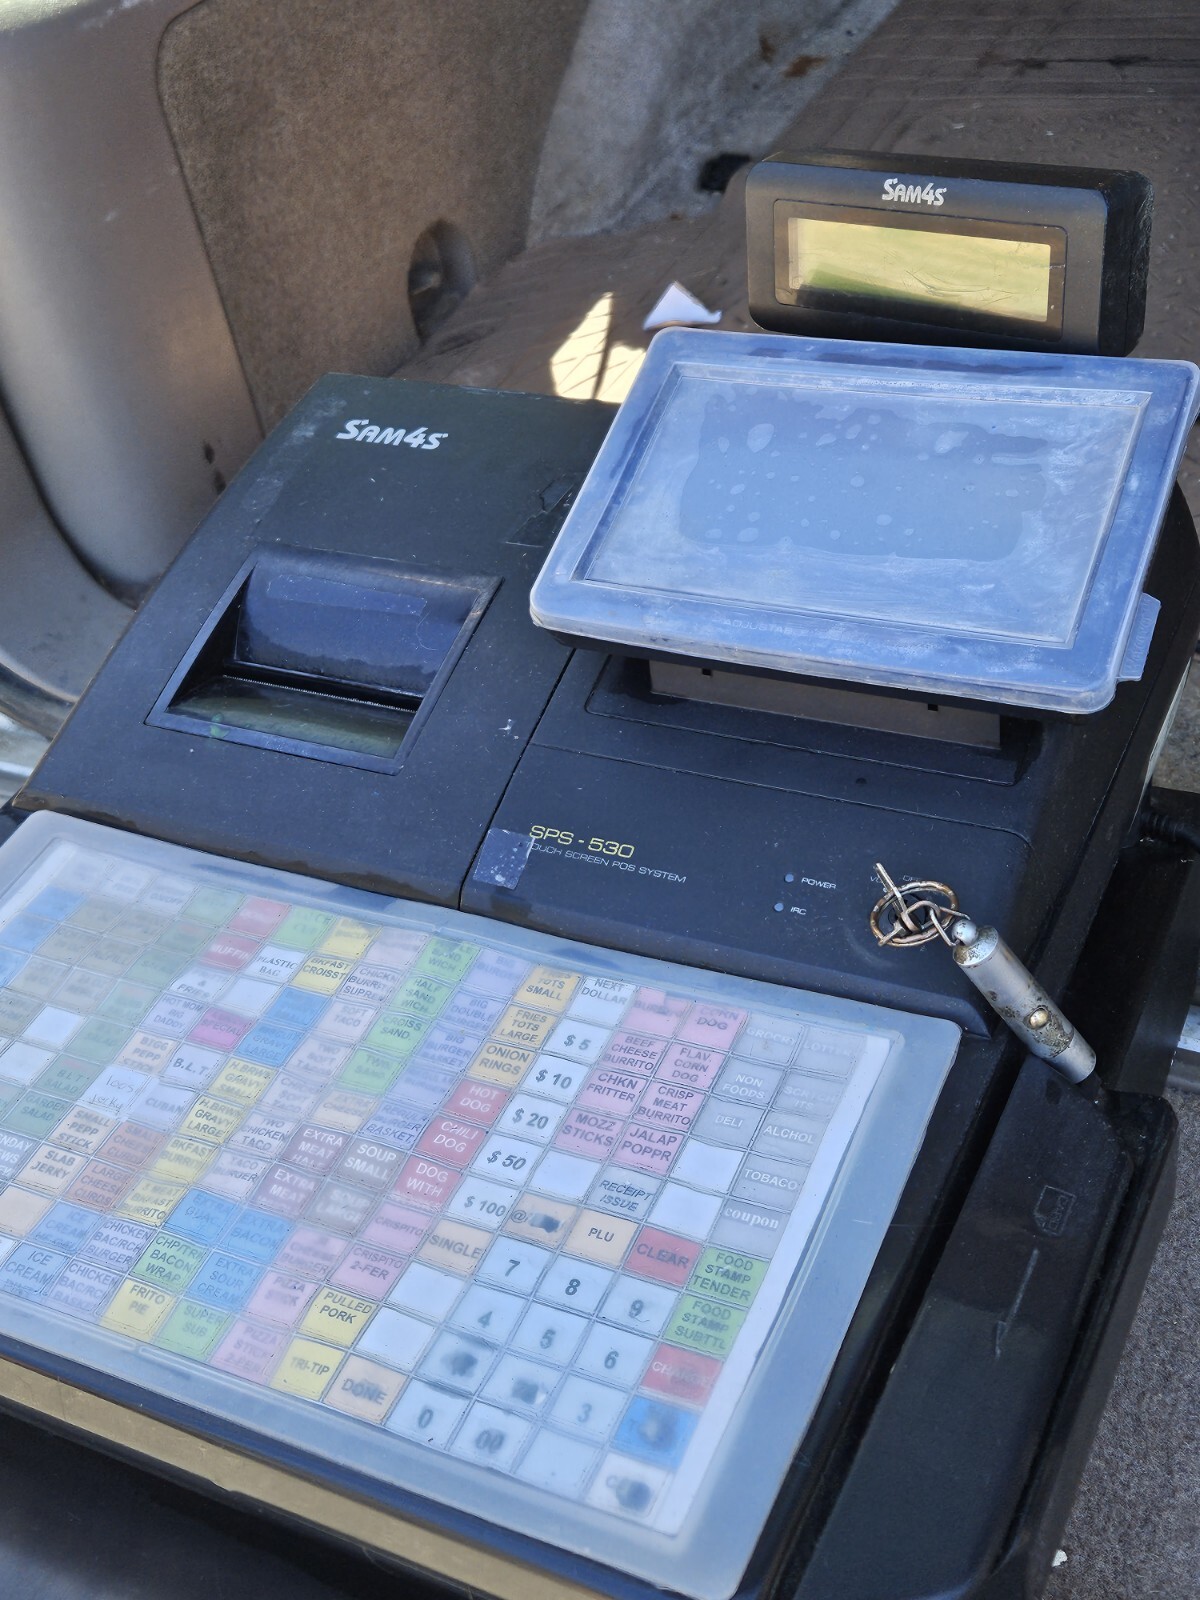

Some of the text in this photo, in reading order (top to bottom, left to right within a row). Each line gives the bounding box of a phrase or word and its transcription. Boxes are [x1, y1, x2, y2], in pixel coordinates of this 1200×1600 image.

[529, 825, 574, 845] SPS
[588, 837, 635, 859] 530
[565, 850, 609, 866] SCREEN
[612, 861, 635, 872] POS
[638, 866, 687, 884] SYSTEM
[801, 877, 836, 889] POWER
[790, 906, 807, 915] IRC
[257, 956, 298, 970] PLASTIC
[259, 965, 281, 977] BAG
[302, 964, 348, 981] CROISST
[414, 977, 441, 992] HALF
[526, 985, 563, 1001] SMALL
[537, 979, 566, 990] TOTS
[594, 979, 625, 993] NEXT
[160, 994, 182, 1007] HOT
[405, 988, 437, 1004] SAND
[468, 999, 489, 1009] BIG
[581, 987, 629, 1006] DOLLAR
[341, 1005, 369, 1017] SOFT
[400, 999, 430, 1014] WICH
[450, 1005, 497, 1020] DOUBLE
[152, 1014, 187, 1030] DADDY
[334, 1014, 362, 1028] TACO
[383, 1015, 422, 1031] CROISS
[515, 1009, 548, 1023] FRIES
[696, 1016, 729, 1031] DOG
[200, 1018, 243, 1037] SPECIAL
[511, 1019, 540, 1032] TOTS
[252, 1033, 290, 1050] GRAVY
[445, 1033, 466, 1044] BIG
[500, 1028, 539, 1043] LARGE
[625, 1035, 656, 1049] BEEF
[132, 1047, 162, 1062] PEPP
[425, 1040, 473, 1058] BURGER
[485, 1045, 531, 1063] ONION
[611, 1043, 659, 1060] CHEESE
[479, 1057, 522, 1076] RINGS
[601, 1053, 654, 1071] BURRITO
[673, 1058, 709, 1073] CORN
[552, 1072, 574, 1090] 10
[597, 1072, 639, 1090] CHKN
[671, 1070, 700, 1083] DOG
[735, 1073, 764, 1088] NON
[44, 1078, 80, 1095] SALAD
[468, 1084, 501, 1100] HOT
[586, 1082, 637, 1103] FRITTER
[657, 1085, 695, 1101] CRISP
[722, 1083, 766, 1100] FOODS
[20, 1106, 56, 1121] SALAD
[144, 1097, 184, 1115] CUBAN
[459, 1096, 491, 1113] DOG
[652, 1097, 688, 1112] MEAT
[73, 1110, 111, 1128] SMALL
[194, 1108, 232, 1128] GRAVY
[262, 1117, 286, 1130] TWO
[526, 1112, 550, 1130] 20
[576, 1113, 617, 1132] MOZZ
[637, 1106, 692, 1126] BURRITO
[714, 1114, 744, 1128] DELI
[67, 1121, 99, 1137] PEPP
[186, 1119, 226, 1138] LARGE
[239, 1125, 290, 1144] CHICKEN
[303, 1128, 344, 1147] EXTRA
[440, 1121, 479, 1141] CHILI
[561, 1124, 614, 1147] STICKS
[629, 1127, 678, 1147] JALAP
[763, 1125, 815, 1145] ALCHOL
[55, 1132, 94, 1150] STICK
[169, 1138, 212, 1158] BKFAST
[240, 1136, 273, 1151] TACO
[298, 1141, 336, 1159] MEAT
[433, 1133, 467, 1153] DOG
[44, 1150, 77, 1168] SLAB
[356, 1143, 397, 1162] SOUP
[620, 1140, 672, 1161] POPPR
[30, 1161, 70, 1181] JERKY
[230, 1156, 259, 1170] TACO
[343, 1156, 389, 1180] SMALL
[501, 1154, 527, 1171] 50
[91, 1164, 131, 1182] LARGE
[273, 1168, 316, 1191] EXTRA
[415, 1162, 449, 1183] DOG
[744, 1168, 798, 1190] TOBACO
[268, 1184, 307, 1203] MEAT
[405, 1176, 443, 1198] WITH
[600, 1179, 655, 1201] RECEIPT
[73, 1188, 112, 1207] CURDS
[600, 1195, 639, 1212] ISSUE
[67, 1210, 92, 1221] ICE
[120, 1202, 167, 1220] BURRITO
[480, 1199, 507, 1217] 100
[374, 1216, 424, 1237] CRISPITO
[724, 1207, 780, 1229] coupon
[45, 1219, 87, 1238] CREAM
[102, 1219, 153, 1242] CHICKEN
[587, 1227, 615, 1243] PLU
[93, 1231, 142, 1253] BAC/RCH
[428, 1234, 484, 1260] SINGLE
[26, 1250, 54, 1266] ICE
[86, 1244, 133, 1265] BURGER
[149, 1248, 193, 1273] BACON
[352, 1246, 403, 1270] CRISPITO
[636, 1243, 691, 1270] CLEAR
[715, 1251, 754, 1272] FOOD
[4, 1260, 50, 1286] CREAM
[144, 1262, 182, 1283] WRAP
[214, 1256, 255, 1278] EXTRA
[349, 1260, 390, 1281] 2-FER
[504, 1259, 520, 1277] 7
[704, 1263, 752, 1285] STAMP
[209, 1269, 244, 1290] SOUR
[564, 1278, 581, 1296] 8
[692, 1274, 752, 1302] TENDER
[130, 1284, 167, 1305] FRITO
[323, 1290, 373, 1314] PULLED
[127, 1300, 151, 1316] PIE
[183, 1304, 222, 1326] SUPER
[318, 1304, 358, 1325] PORK
[628, 1298, 645, 1319] 9
[691, 1299, 732, 1321] FOOD
[477, 1310, 493, 1329] 4
[681, 1312, 730, 1334] STAMP
[539, 1327, 557, 1350] 5
[674, 1324, 727, 1350] SUBTTL
[289, 1355, 331, 1377] TRI-TIP
[603, 1350, 620, 1370] 6
[341, 1377, 387, 1404] DONE
[417, 1406, 435, 1430] 0
[577, 1402, 593, 1424] 3
